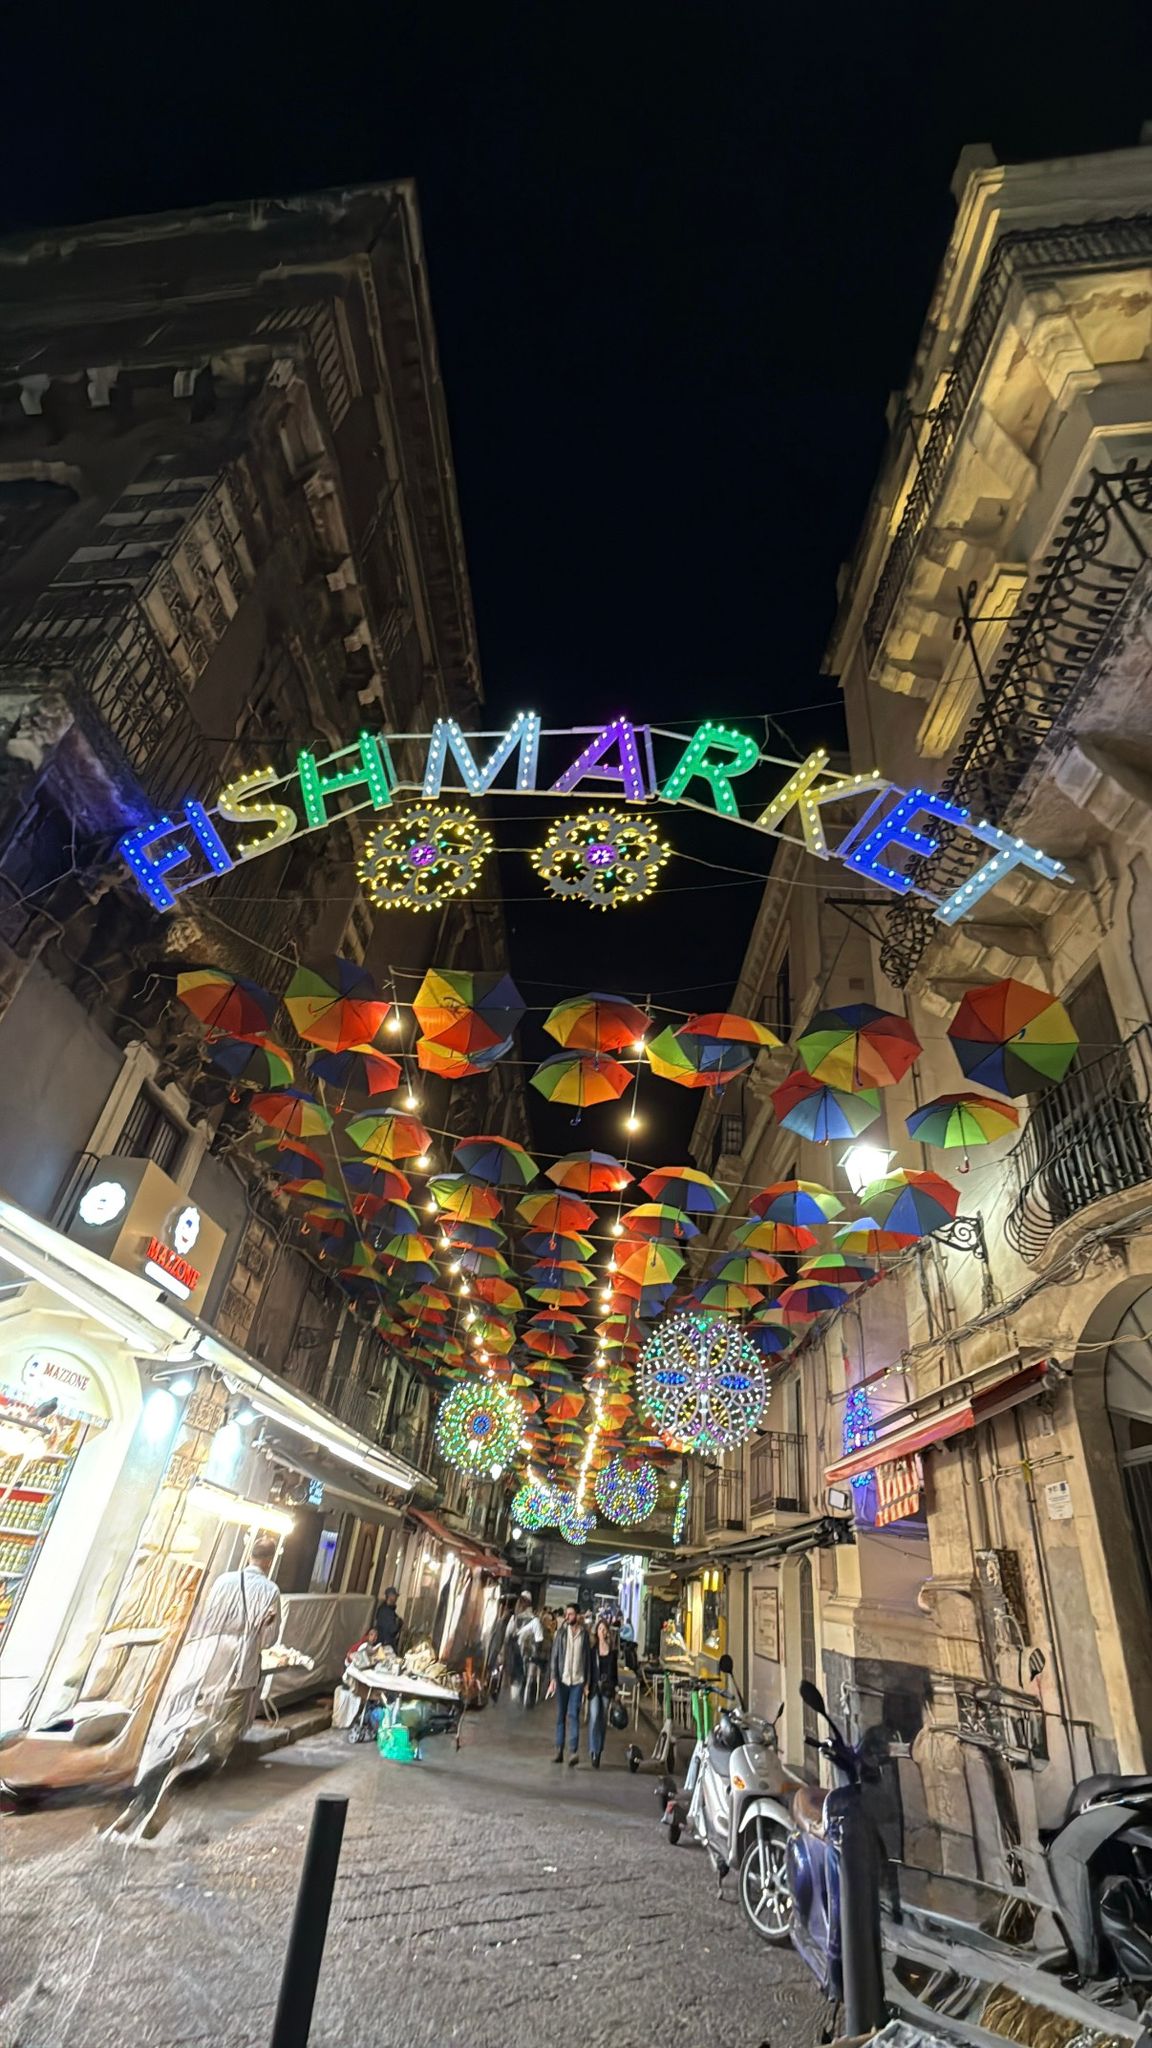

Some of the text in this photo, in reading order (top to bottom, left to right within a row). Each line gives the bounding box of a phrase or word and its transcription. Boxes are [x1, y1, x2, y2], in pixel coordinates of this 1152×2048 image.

[120, 712, 1068, 926] FISH MARKET
[146, 1236, 201, 1292] MAZZONE
[43, 1362, 90, 1391] MAZZONE
